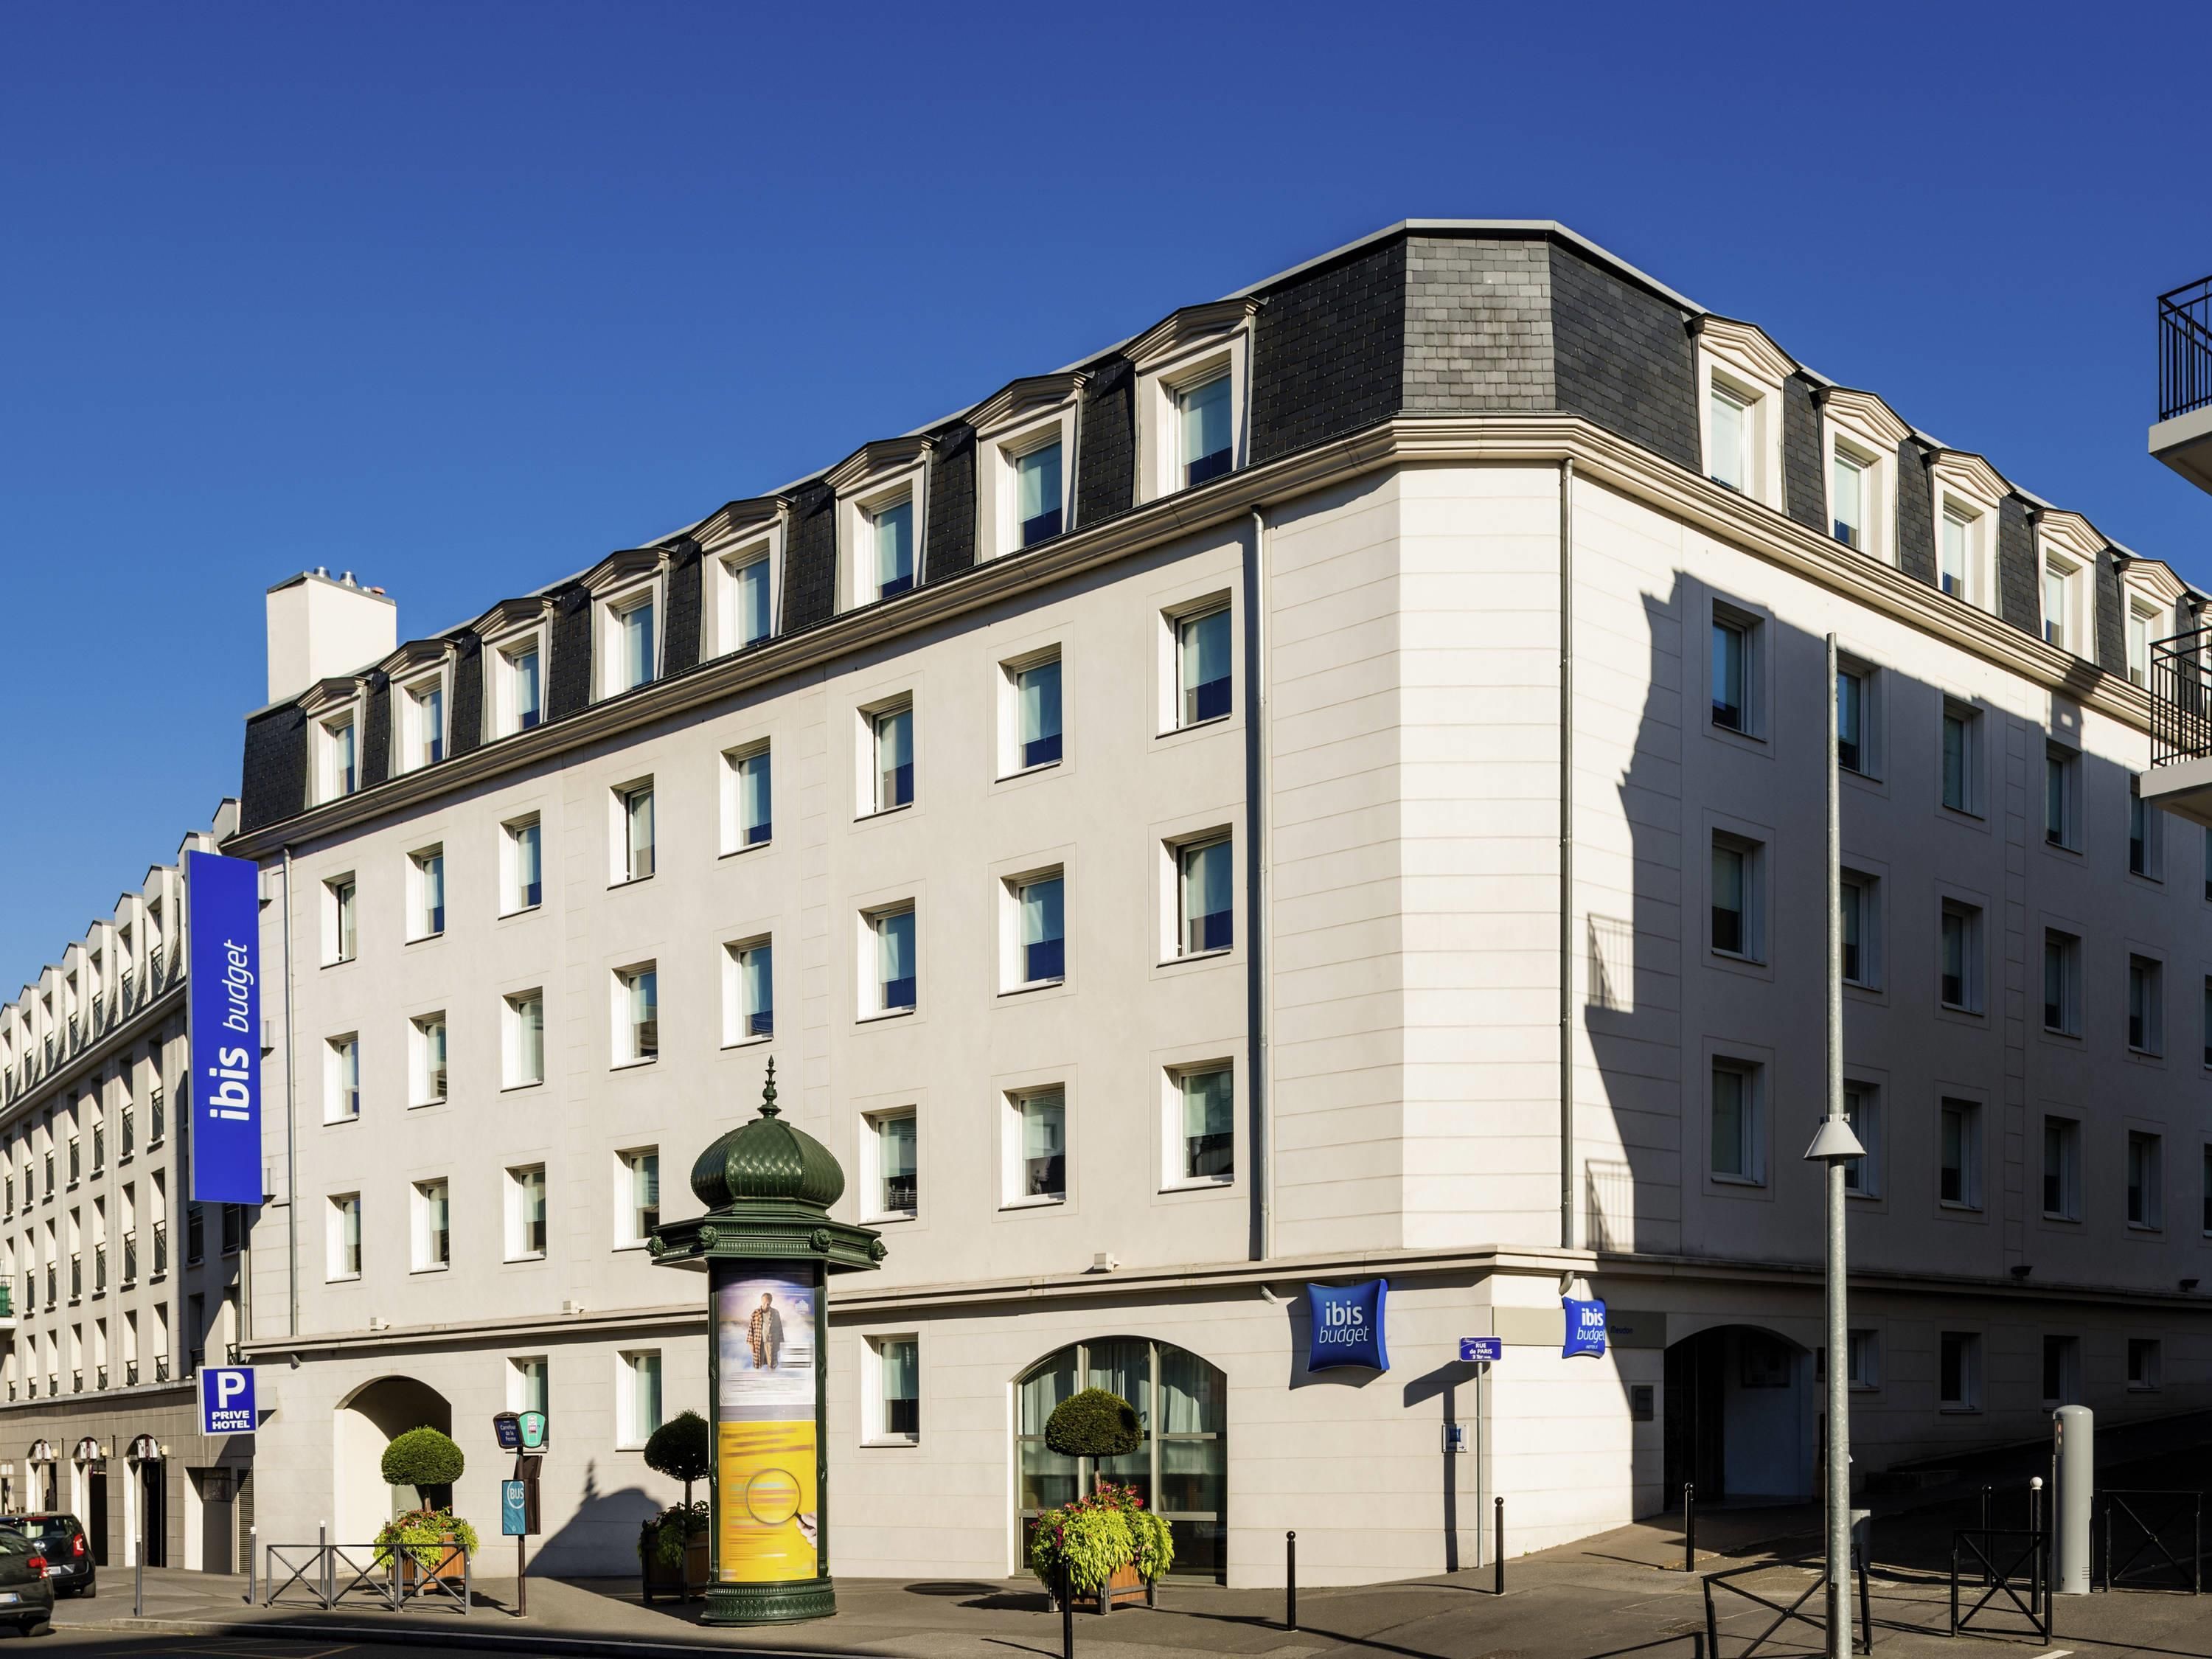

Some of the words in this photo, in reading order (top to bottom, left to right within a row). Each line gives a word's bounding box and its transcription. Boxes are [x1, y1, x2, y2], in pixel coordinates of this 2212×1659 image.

[222, 939, 254, 1032] budget
[209, 1047, 250, 1121] ibis
[1326, 1300, 1363, 1326] ibis
[1582, 1308, 1604, 1326] ibis
[1319, 1325, 1369, 1346] budget
[1577, 1327, 1605, 1343] budget
[217, 1371, 246, 1408] P
[212, 1410, 250, 1420] PRIVE
[212, 1419, 251, 1430] HOTEL
[510, 1488, 524, 1499] BUS
